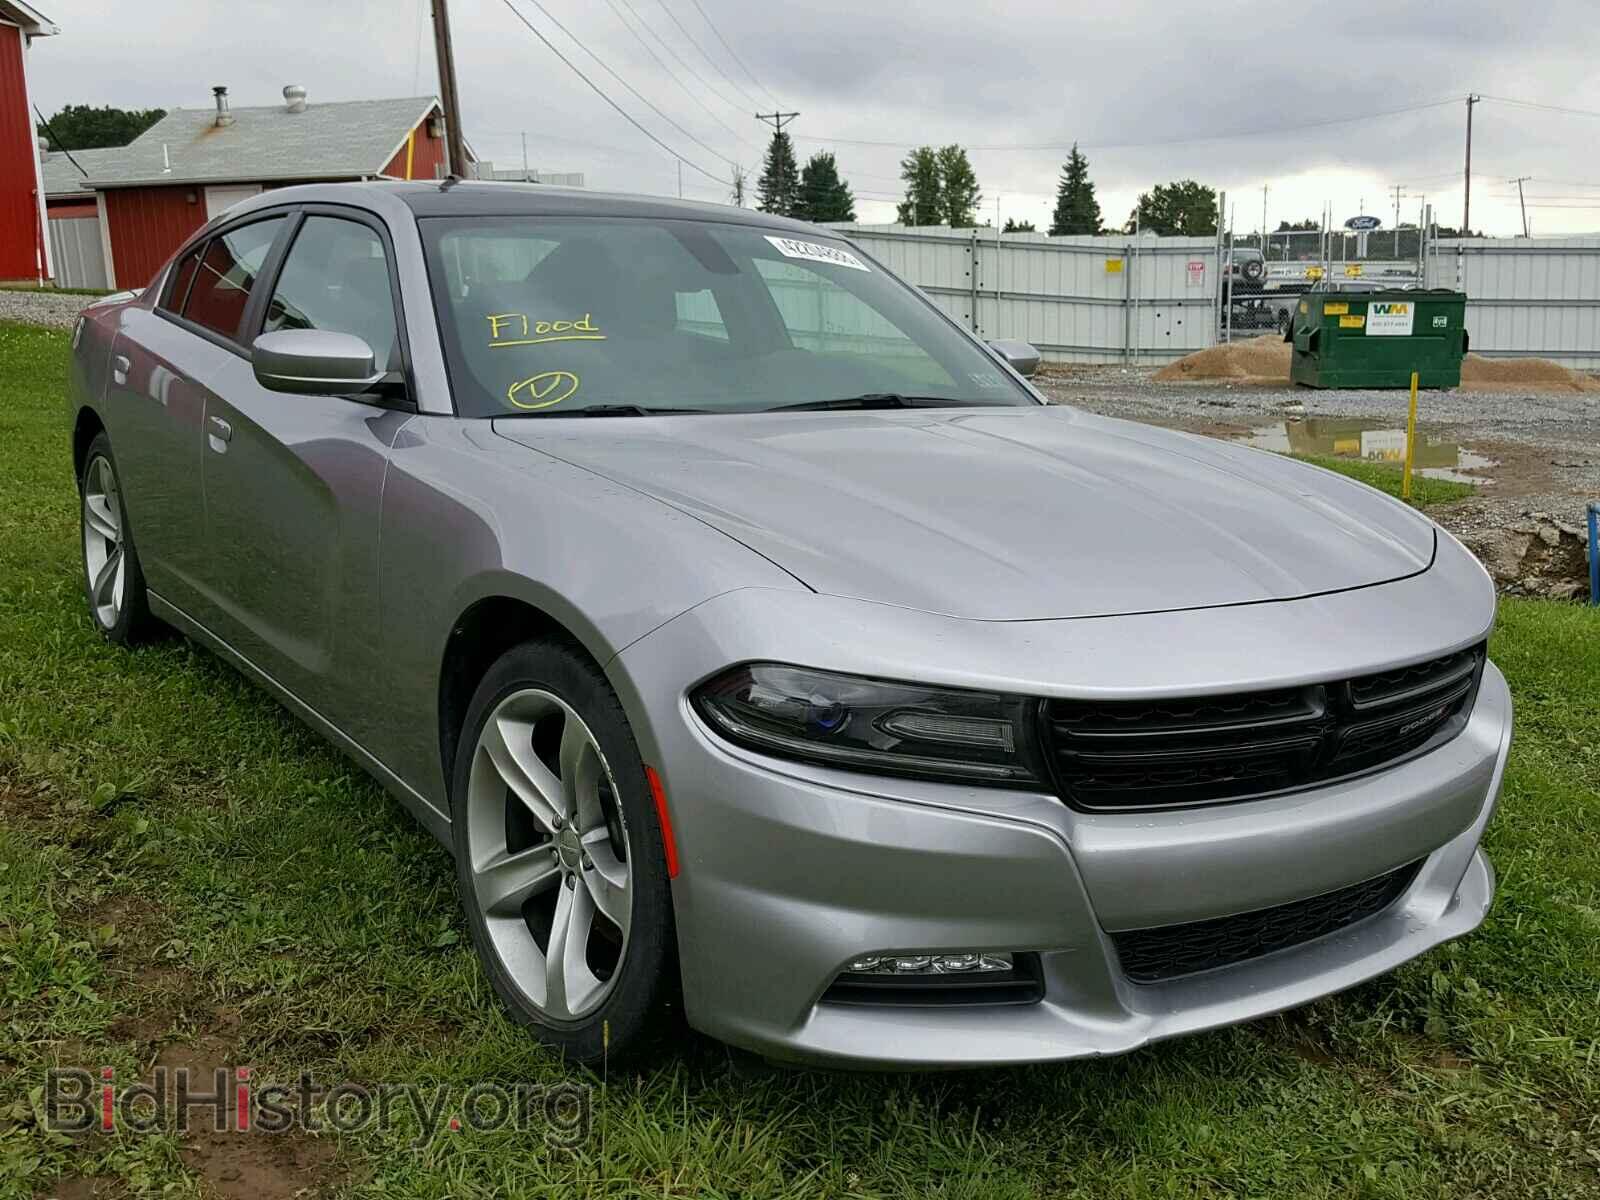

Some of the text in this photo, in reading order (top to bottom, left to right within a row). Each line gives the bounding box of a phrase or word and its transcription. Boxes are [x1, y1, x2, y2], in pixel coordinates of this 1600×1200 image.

[1352, 217, 1376, 229] Ford
[1373, 303, 1409, 315] WM
[486, 312, 600, 339] Flood
[1399, 706, 1442, 734] DODGE
